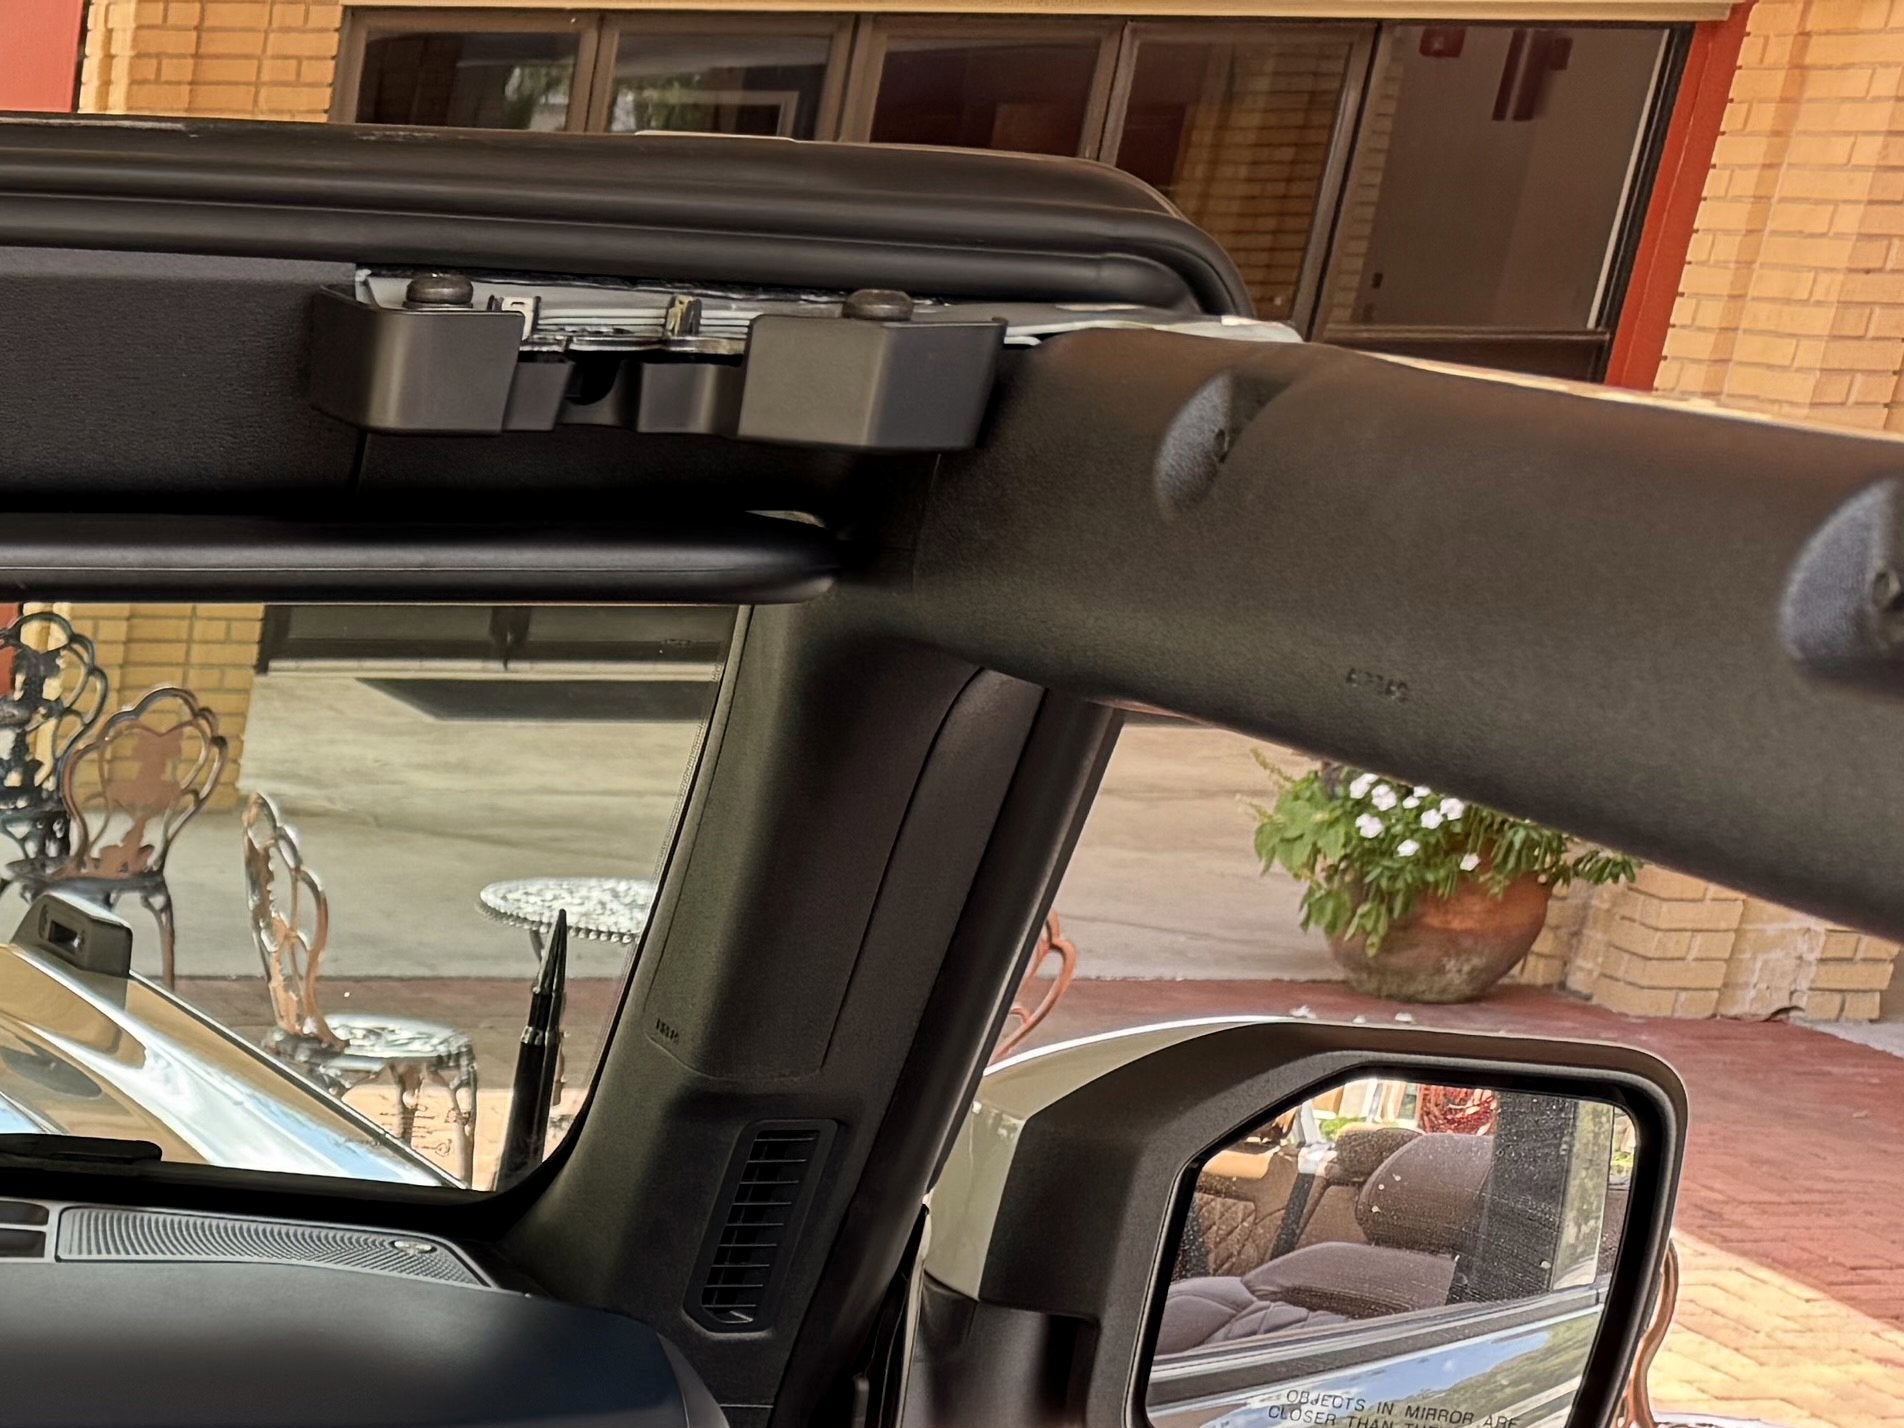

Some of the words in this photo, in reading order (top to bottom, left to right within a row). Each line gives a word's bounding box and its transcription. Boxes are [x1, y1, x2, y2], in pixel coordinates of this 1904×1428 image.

[1268, 1405, 1336, 1426] CLOSER
[1286, 1389, 1366, 1412] OBJECTS
[1376, 1401, 1394, 1417] IN
[1405, 1405, 1474, 1424] MIRROR
